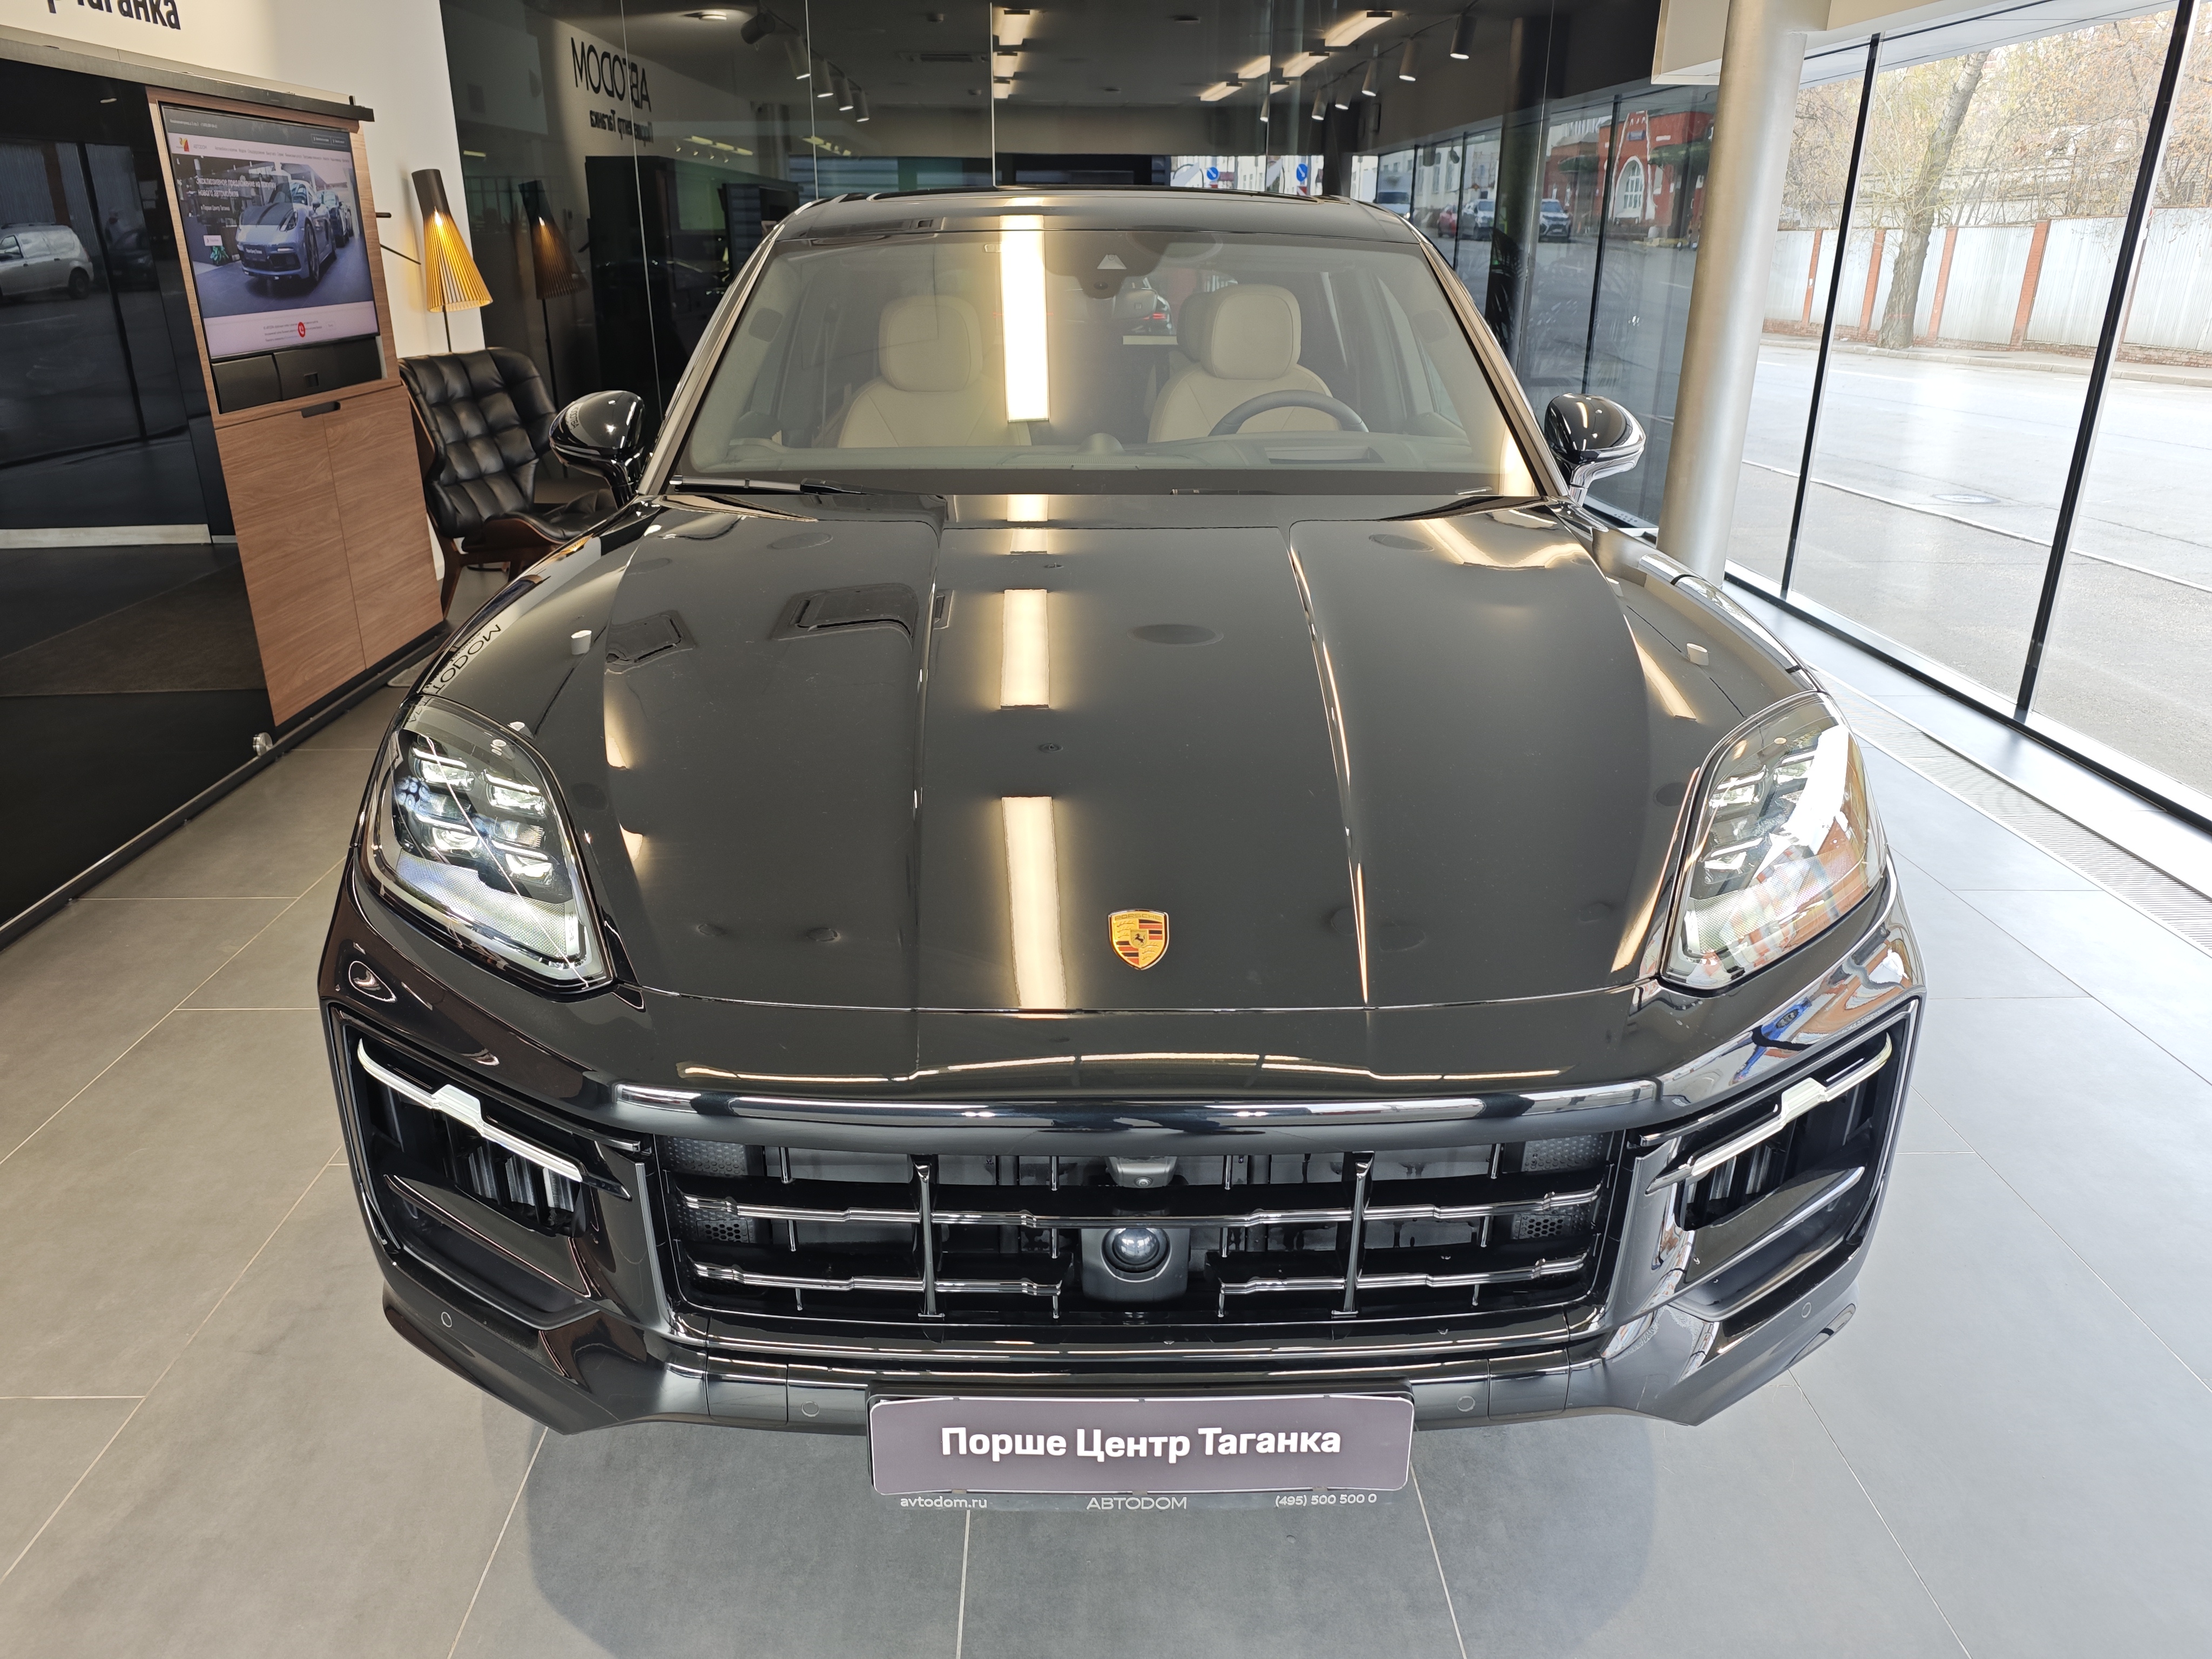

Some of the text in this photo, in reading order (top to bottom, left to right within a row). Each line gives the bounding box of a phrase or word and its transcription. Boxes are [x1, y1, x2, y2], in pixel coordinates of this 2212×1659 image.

[942, 1427, 1341, 1464] Порше Центр Таганка
[900, 1495, 987, 1508] avtodom.ru
[1276, 1493, 1377, 1507] (495) 500 500 0
